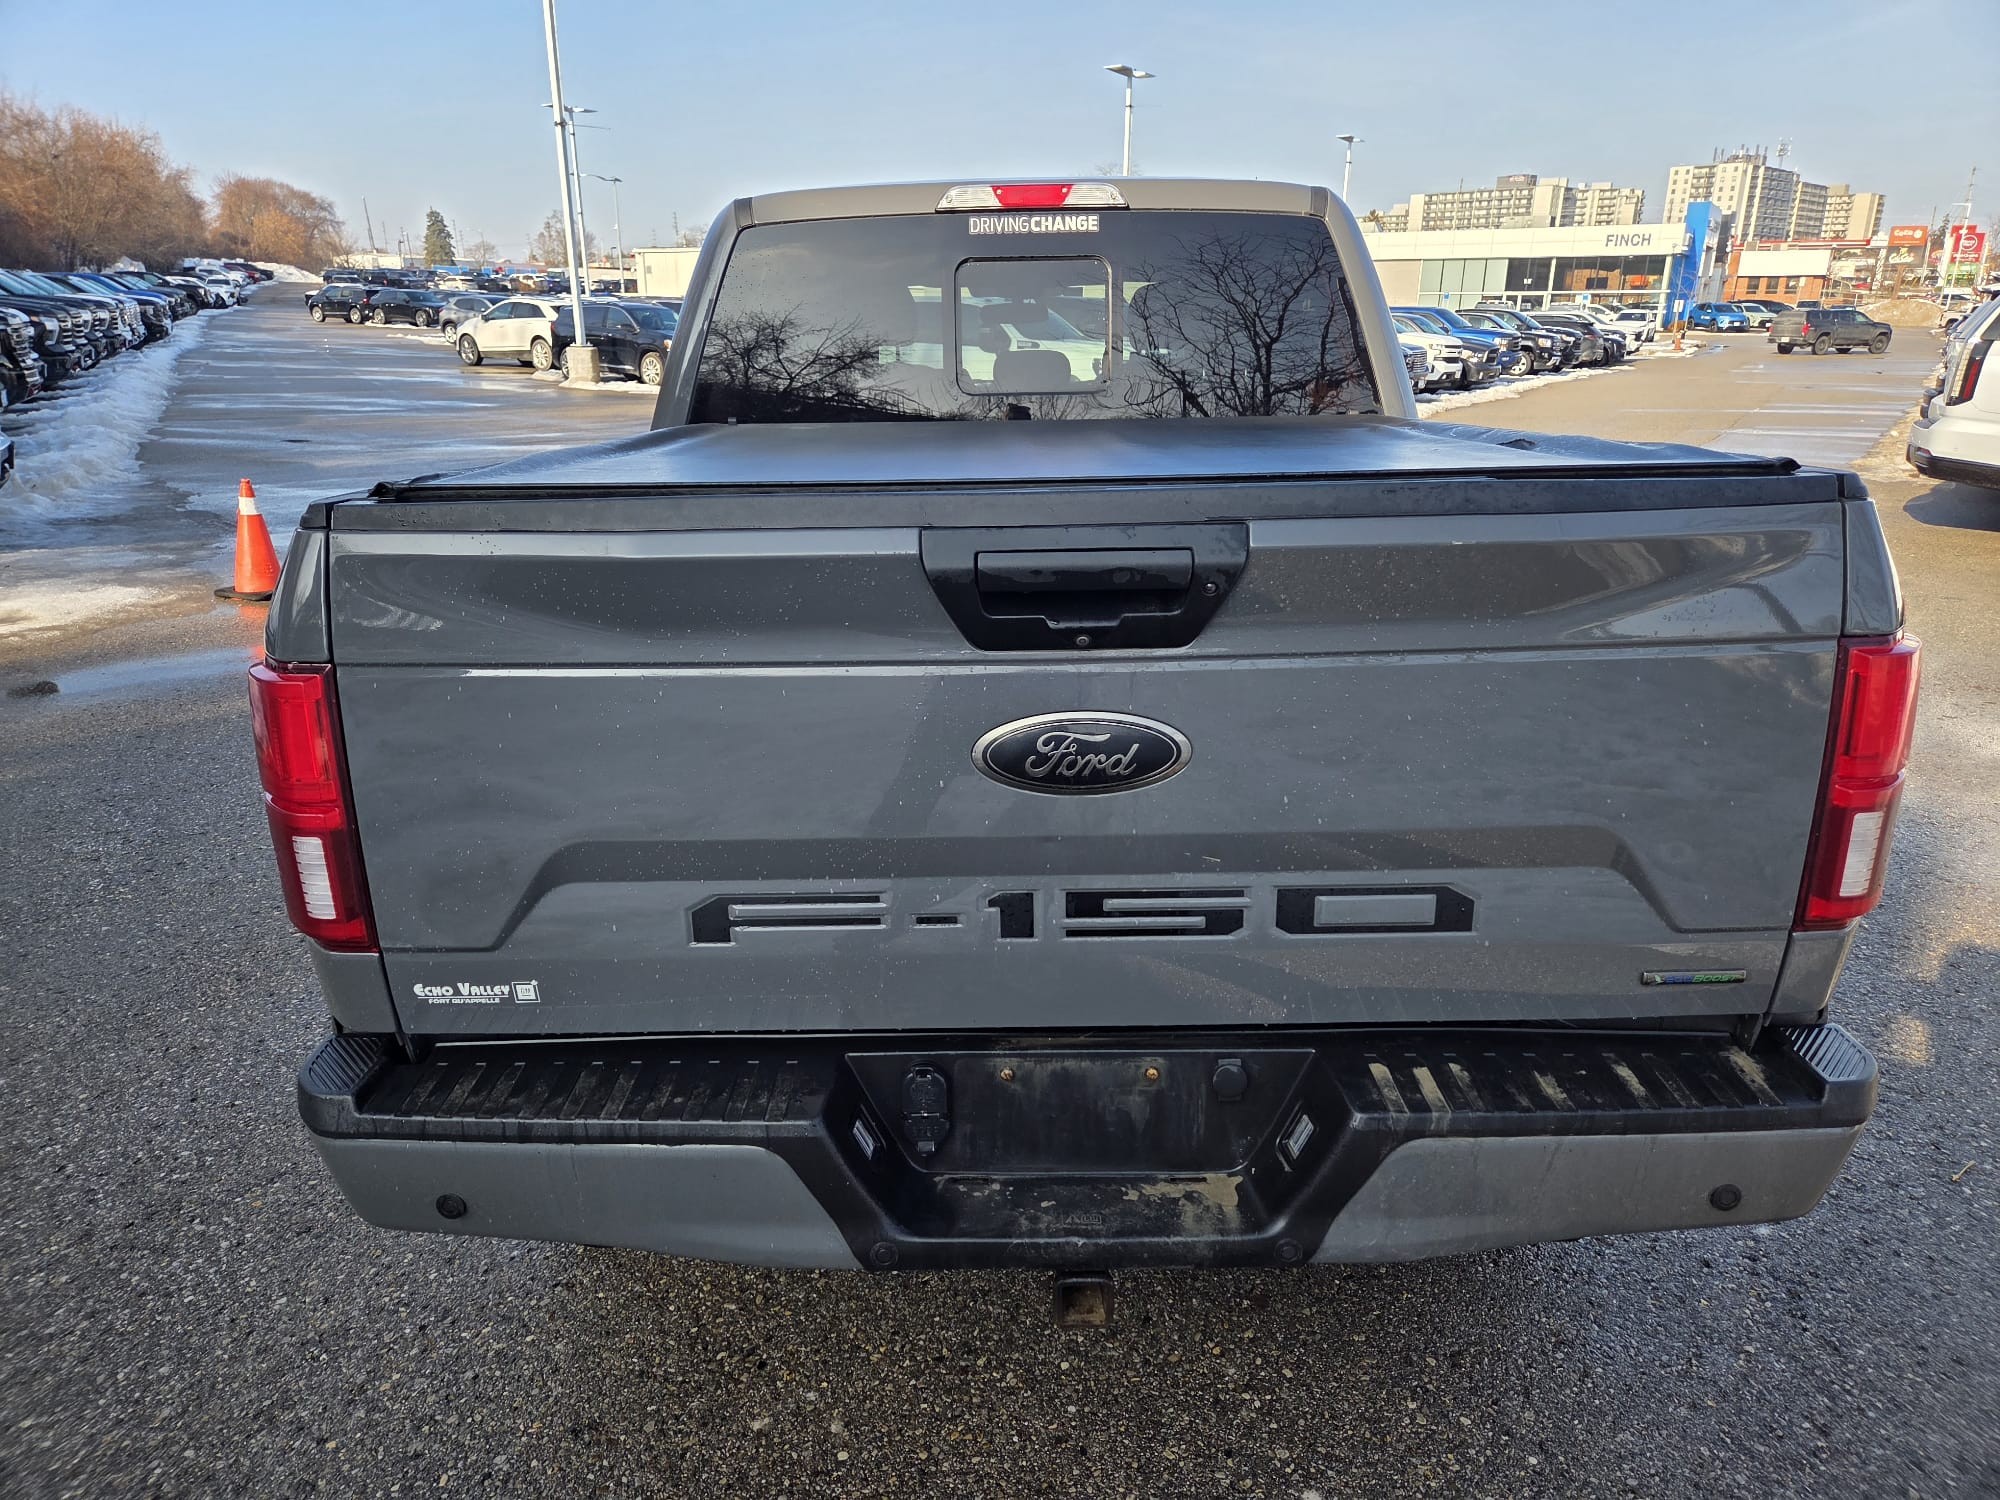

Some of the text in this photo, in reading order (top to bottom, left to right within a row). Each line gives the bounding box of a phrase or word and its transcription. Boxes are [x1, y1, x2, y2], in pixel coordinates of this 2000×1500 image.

[969, 214, 1099, 234] DRIVINGCHANGE
[1605, 233, 1652, 247] FINCH
[1025, 731, 1139, 778] Ford
[689, 884, 1475, 945] F-150
